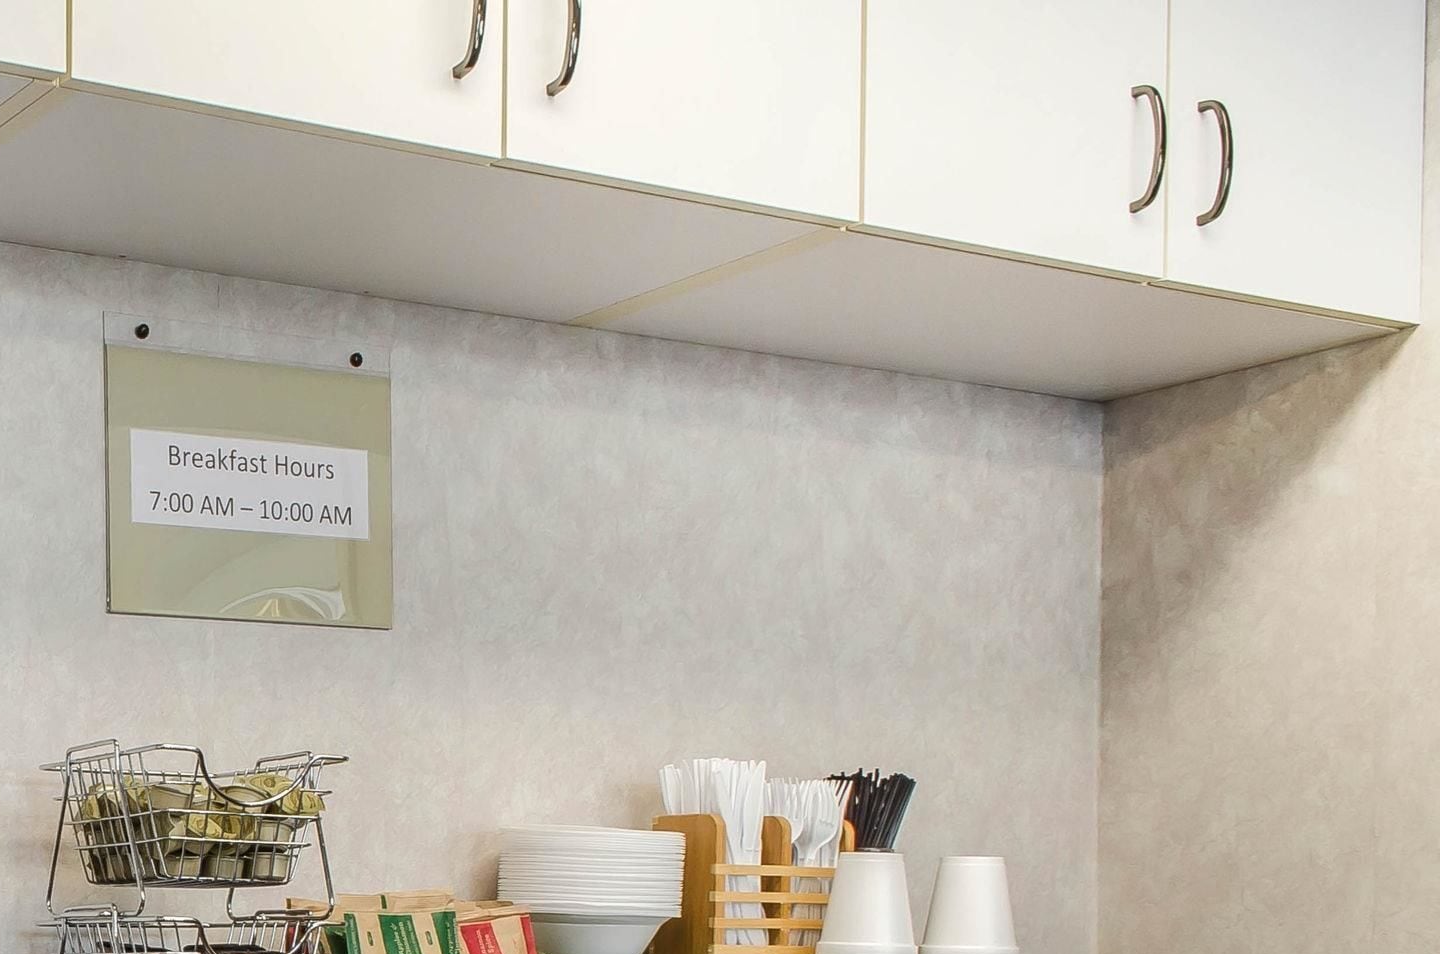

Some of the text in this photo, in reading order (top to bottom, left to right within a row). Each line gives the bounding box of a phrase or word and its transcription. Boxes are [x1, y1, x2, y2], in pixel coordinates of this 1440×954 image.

[168, 445, 334, 480] Breakfast Hours
[149, 491, 194, 513] 7:00
[200, 495, 234, 517] AM
[260, 500, 313, 523] 10:00
[319, 505, 352, 526] AM
